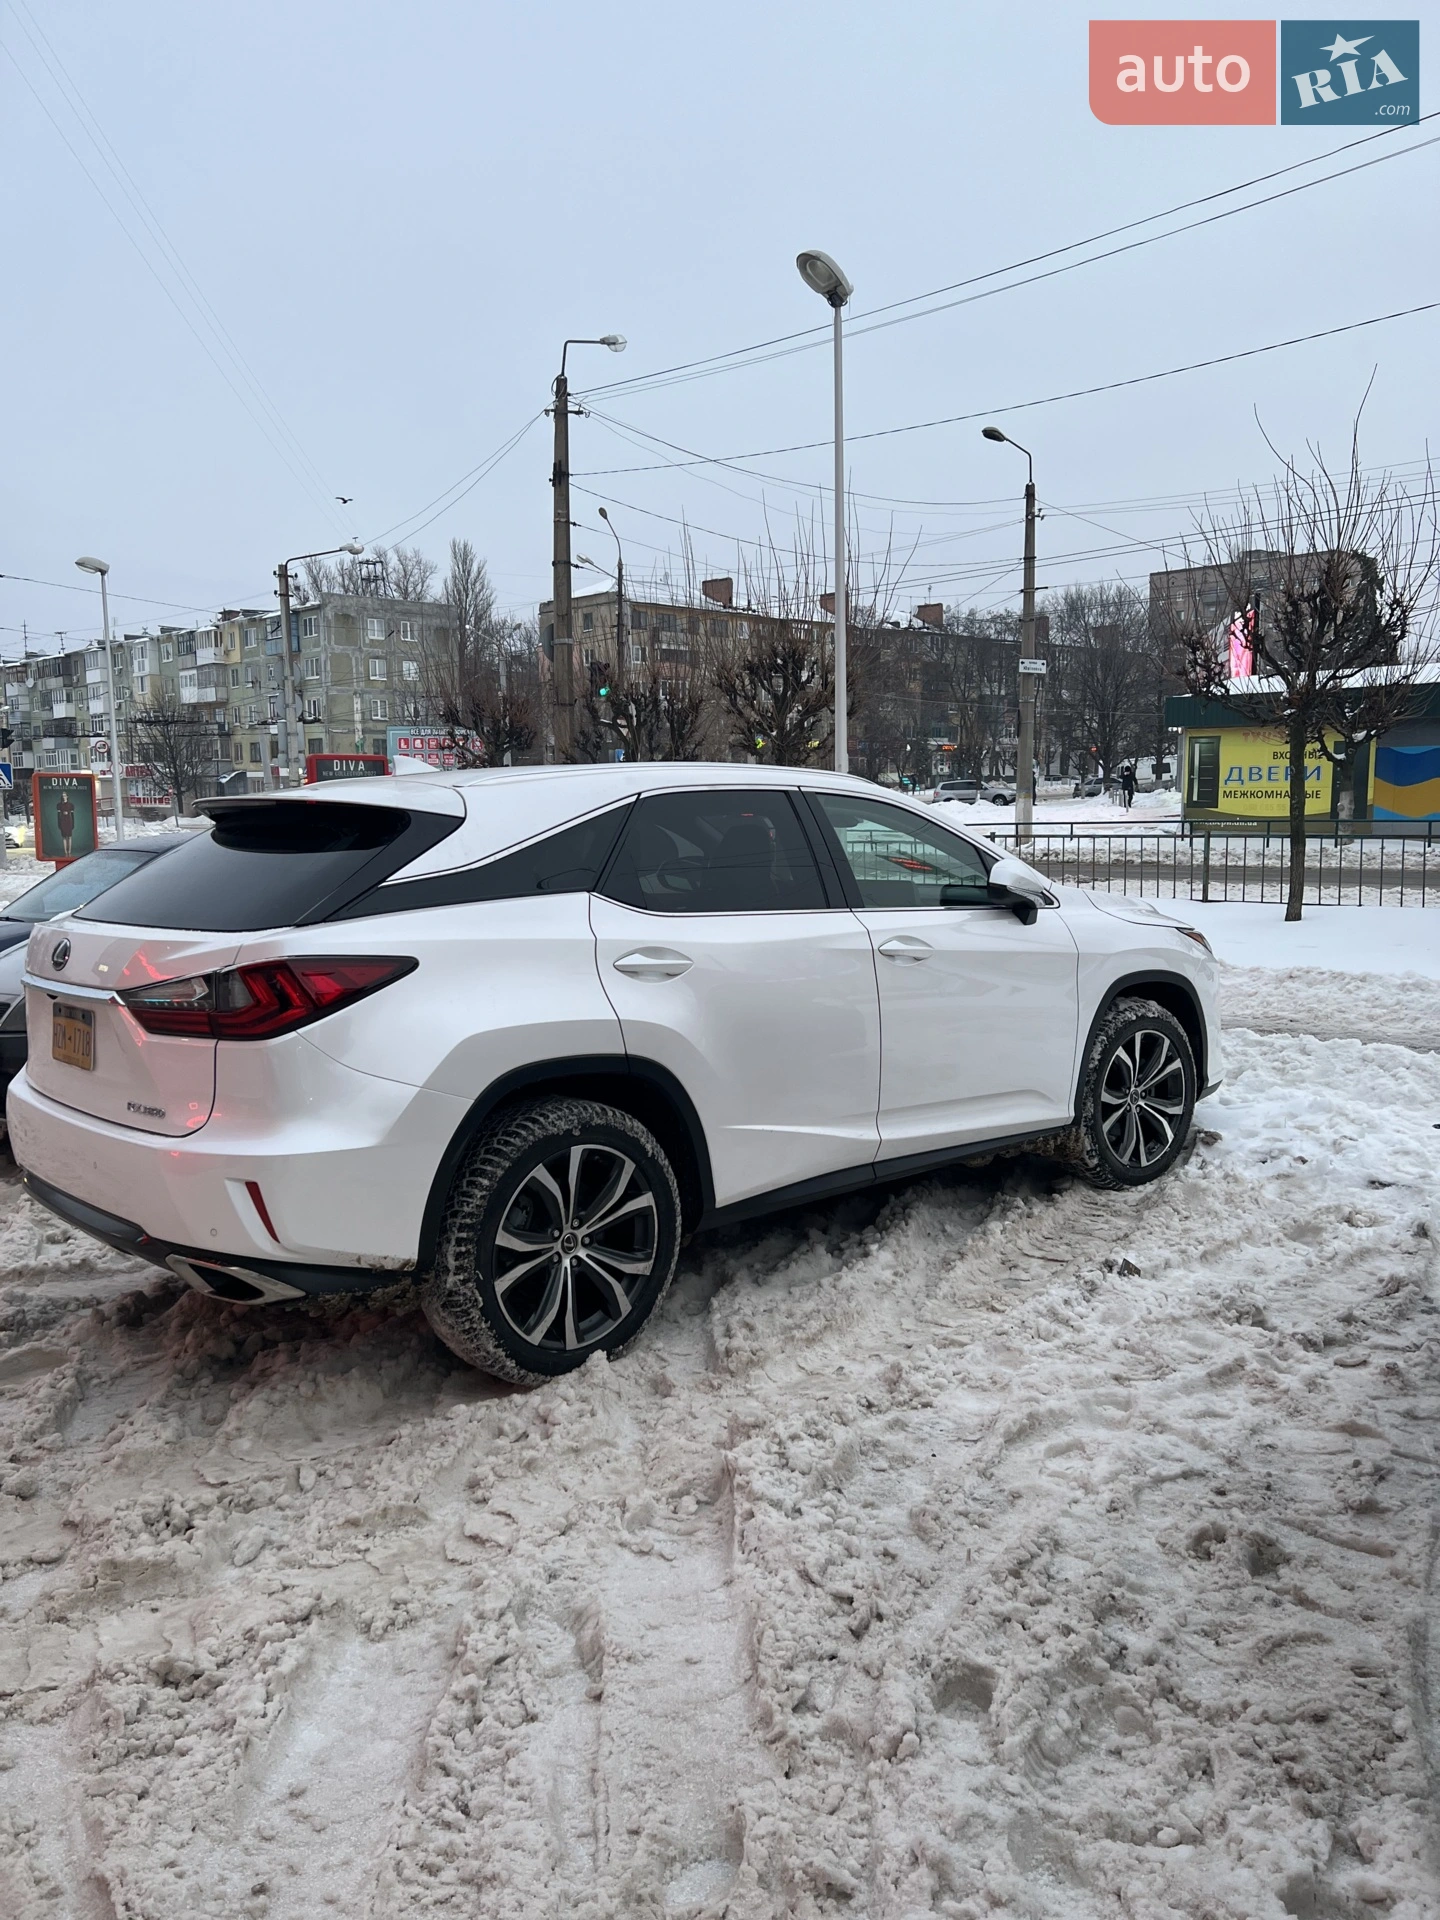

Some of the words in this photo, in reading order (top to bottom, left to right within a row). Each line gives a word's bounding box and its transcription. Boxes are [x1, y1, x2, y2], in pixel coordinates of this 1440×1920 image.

[333, 759, 366, 772] DIVA
[51, 777, 78, 786] DIVA
[1222, 789, 1322, 799] МЕЖКОМНАЫЕ
